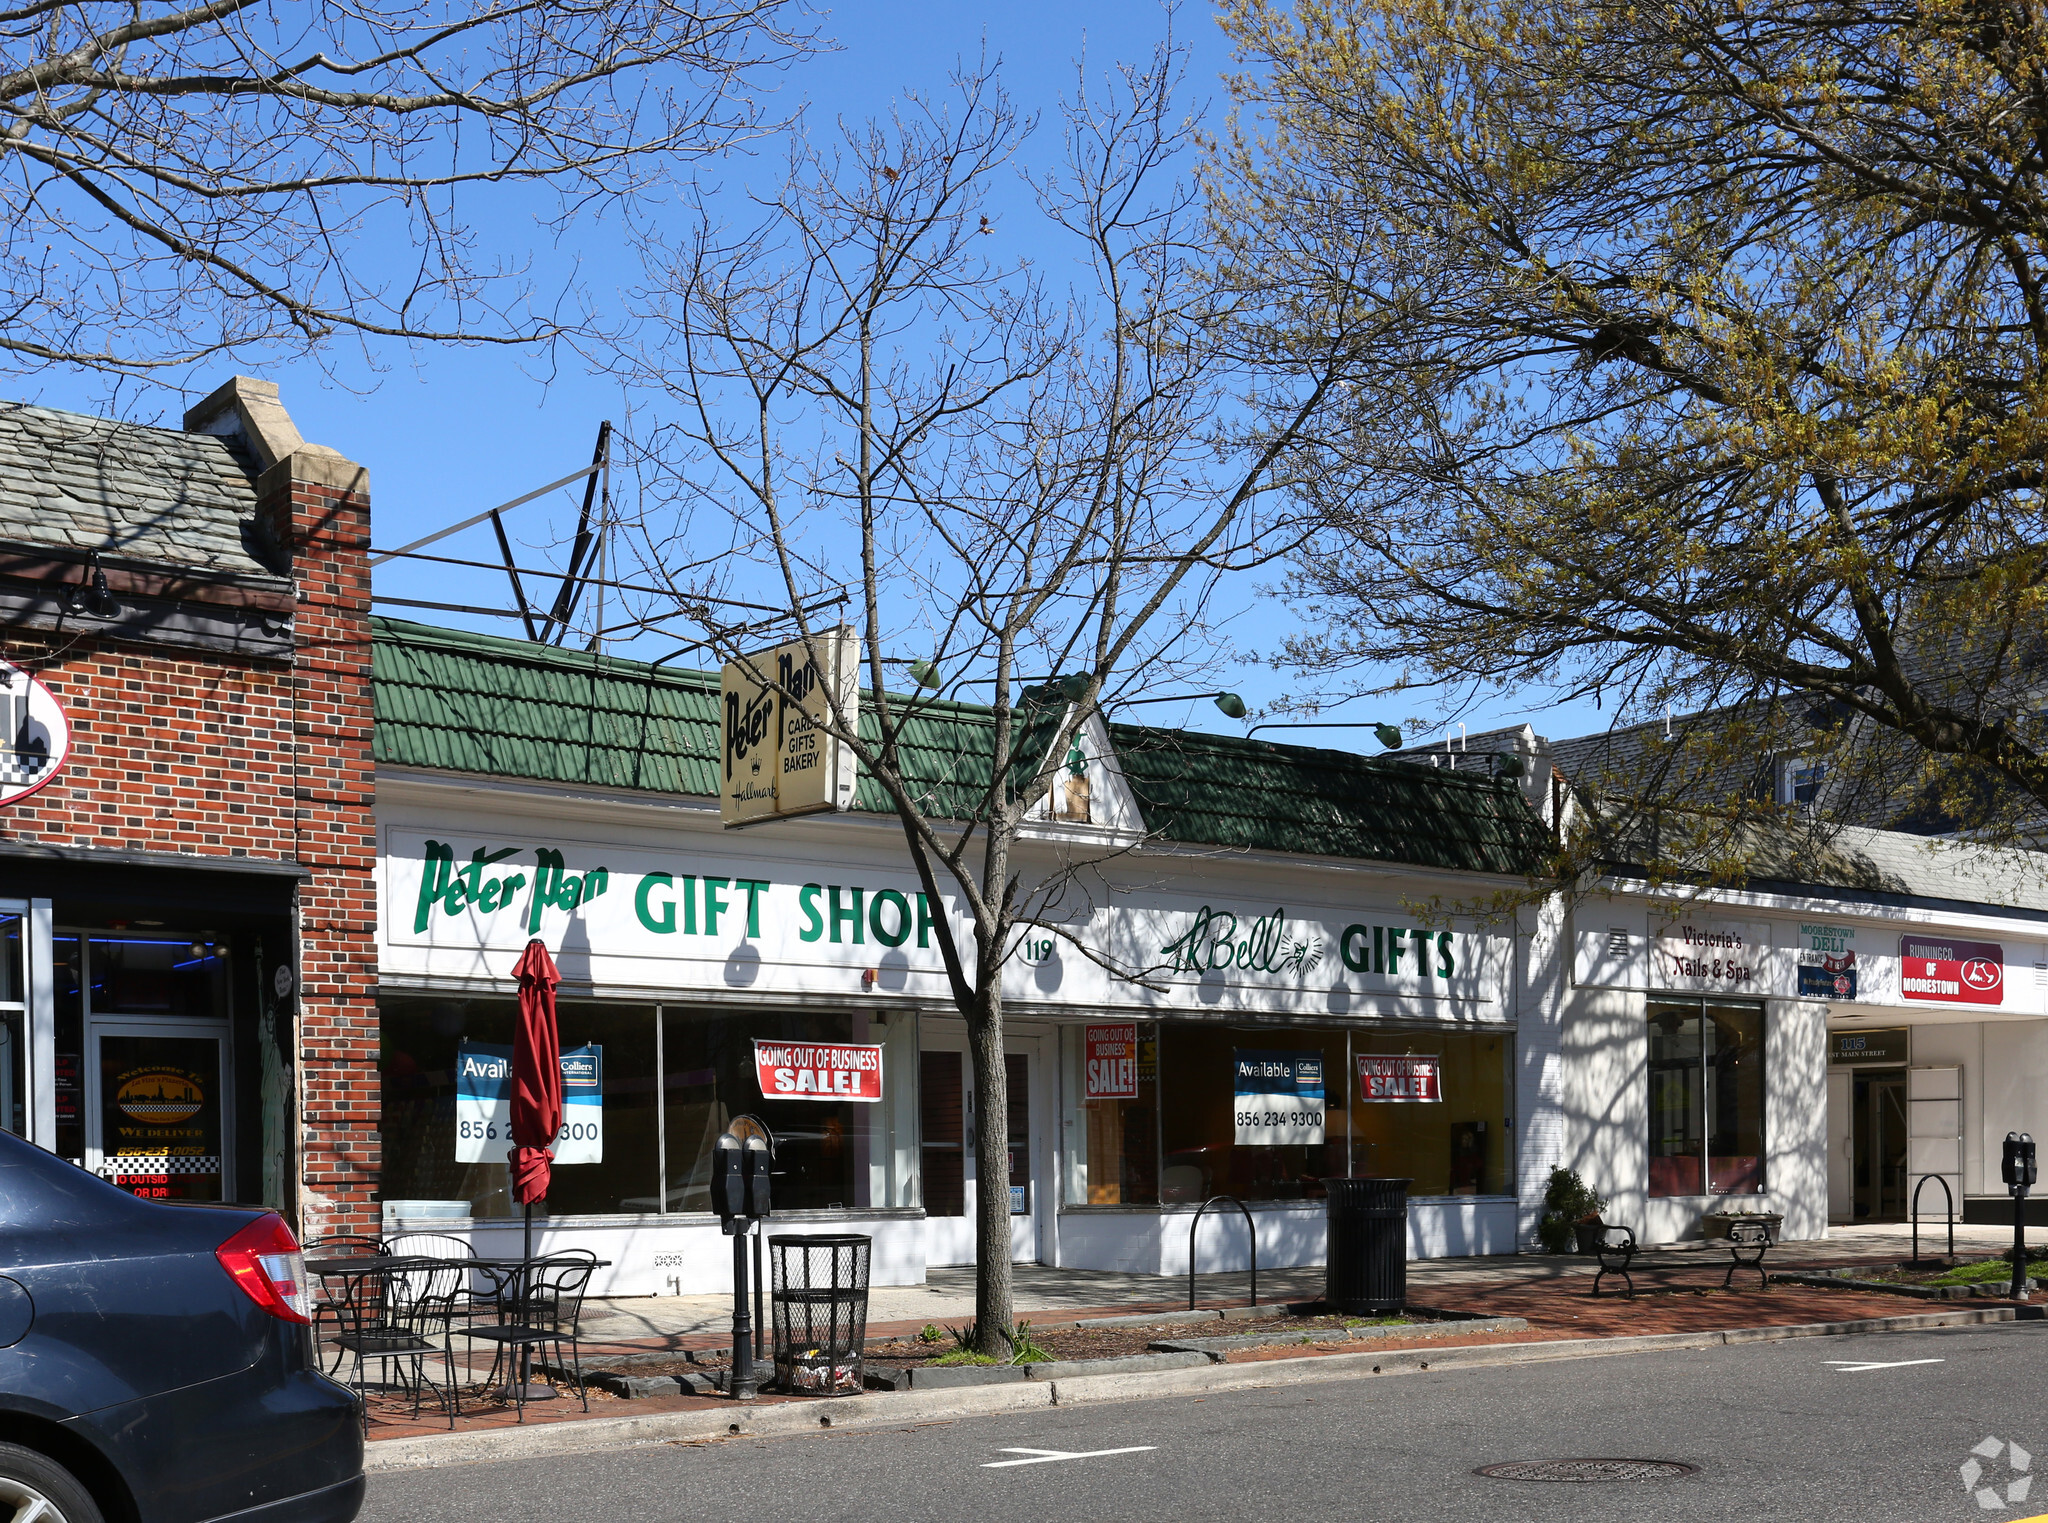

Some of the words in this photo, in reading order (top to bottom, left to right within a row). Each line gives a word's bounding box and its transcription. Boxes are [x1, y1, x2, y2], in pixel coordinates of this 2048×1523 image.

[778, 652, 814, 752] Pan
[725, 680, 773, 783] Peter
[789, 733, 815, 754] GIFTS
[784, 751, 820, 774] BAKERY
[731, 776, 780, 812] Hallmark
[414, 839, 525, 935] Peter
[527, 847, 609, 937] Pan
[635, 871, 771, 939] GIFT
[1682, 925, 1742, 950] Victoria's
[1801, 924, 1855, 938] MOORESTOWN
[1025, 939, 1053, 961] 119
[1340, 923, 1455, 979] GIFTS
[1812, 936, 1845, 952] DELI
[1673, 957, 1708, 978] Nails
[1712, 958, 1722, 979] &
[1726, 959, 1751, 984] Spa
[1925, 962, 1937, 977] OF
[1903, 977, 1960, 996] MOORESTOWN
[1088, 1028, 1110, 1042] GOING
[1110, 1029, 1124, 1041] OUT
[1124, 1028, 1134, 1041] OF
[1841, 1037, 1866, 1050] 115
[760, 1046, 792, 1067] GOING
[793, 1047, 815, 1068] OUT
[816, 1049, 830, 1069] OF
[831, 1050, 877, 1070] BUSINESS
[1096, 1043, 1126, 1056] BUSINESS
[116, 1066, 185, 1080] Welcome
[462, 1057, 513, 1079] Avail
[560, 1061, 593, 1072] Colliers
[1088, 1058, 1134, 1094] SALE!
[1238, 1061, 1290, 1078] Available
[1298, 1062, 1319, 1072] Colliers
[1360, 1060, 1381, 1076] GOING
[1381, 1060, 1396, 1076] OUT
[1397, 1061, 1406, 1076] OF
[1406, 1062, 1438, 1077] BUSINESS
[774, 1068, 861, 1093] SALE!
[1370, 1077, 1428, 1096] SALE!
[1236, 1112, 1260, 1126] 856
[1264, 1112, 1286, 1126] 234
[1291, 1112, 1322, 1126] 9300
[119, 1127, 144, 1137] WE
[147, 1129, 204, 1137] DELIVER
[460, 1121, 497, 1140] 856
[559, 1123, 598, 1141] 300
[117, 1146, 205, 1156] 856-235-0052
[134, 1187, 149, 1198] OR
